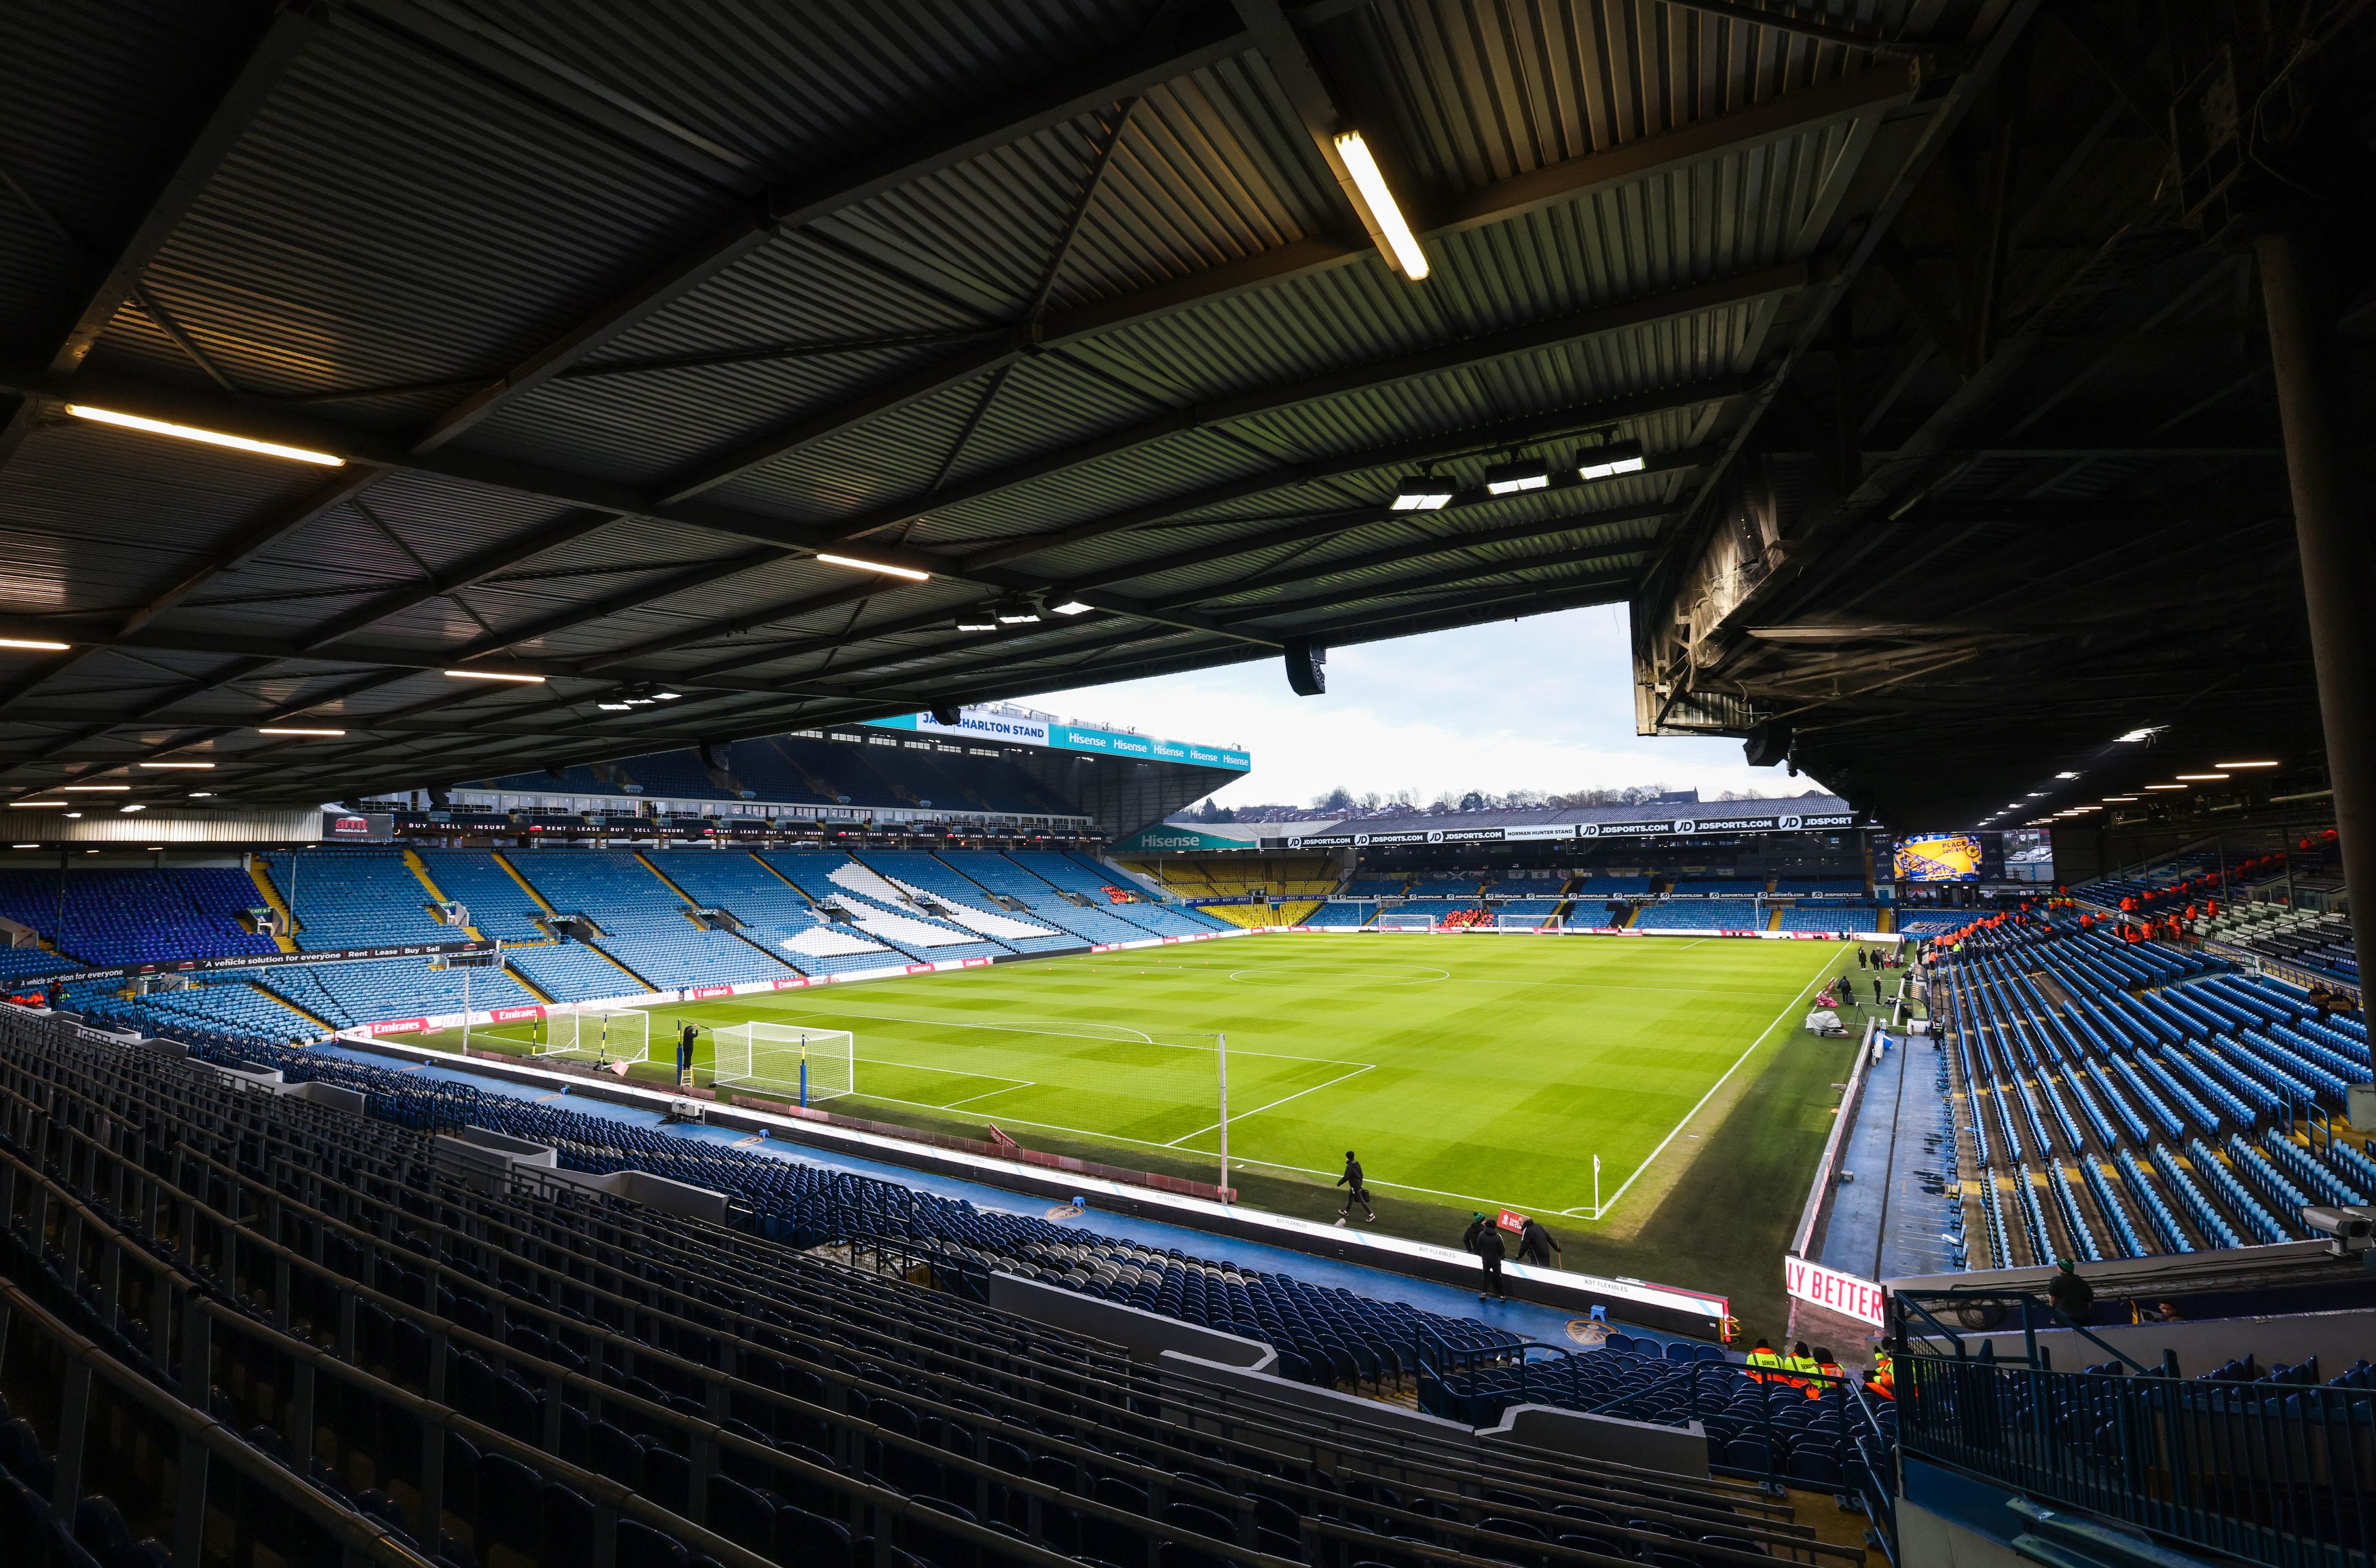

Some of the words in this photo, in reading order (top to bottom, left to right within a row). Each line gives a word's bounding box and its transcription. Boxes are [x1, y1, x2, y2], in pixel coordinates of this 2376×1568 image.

[1013, 725, 1044, 738] STAND
[1069, 732, 1107, 747] Hisense
[1113, 739, 1147, 753] Hisense
[1153, 744, 1184, 758] Hisense
[1190, 749, 1218, 762] Hisense
[1223, 754, 1248, 766] Hisense
[335, 817, 368, 829] amt
[1677, 821, 1692, 832] JD
[1698, 820, 1772, 830] JDSPORTS.COM
[1782, 817, 1799, 827] JD
[1582, 825, 1595, 835] JD
[1601, 824, 1669, 834] JDSPORTS.COM
[1141, 835, 1200, 847] Hisense
[1290, 838, 1299, 846] JD
[1303, 838, 1351, 846] JDSPORTS.COM
[1358, 836, 1367, 844] JD
[1371, 835, 1423, 843] JDSPORTS.COM
[1429, 833, 1441, 842] JD
[1445, 832, 1502, 840] JDSPORTS.COM
[405, 948, 420, 956] Buy
[215, 958, 246, 967] vehicle
[248, 956, 284, 965] solution
[301, 952, 341, 960] everyone
[910, 965, 931, 973] Emirates
[26, 977, 46, 986] vehicle
[75, 973, 86, 982] for
[88, 969, 124, 980] everyone
[778, 980, 804, 988] Emirates
[698, 988, 728, 998] Emirates
[620, 997, 634, 1006] OVER
[441, 1017, 452, 1027] FLY
[453, 1013, 480, 1024] BEER
[499, 1009, 538, 1020] Emirates
[374, 1022, 420, 1034] Emirates
[1164, 1195, 1183, 1203] FLEXIBLES
[1286, 1220, 1307, 1229] FLEXIBLES
[1430, 1248, 1455, 1258] FLEXIBLES
[1597, 1281, 1628, 1292] FLEXIBLES
[1786, 1263, 1805, 1293] LY
[1811, 1270, 1882, 1322] BETTER
